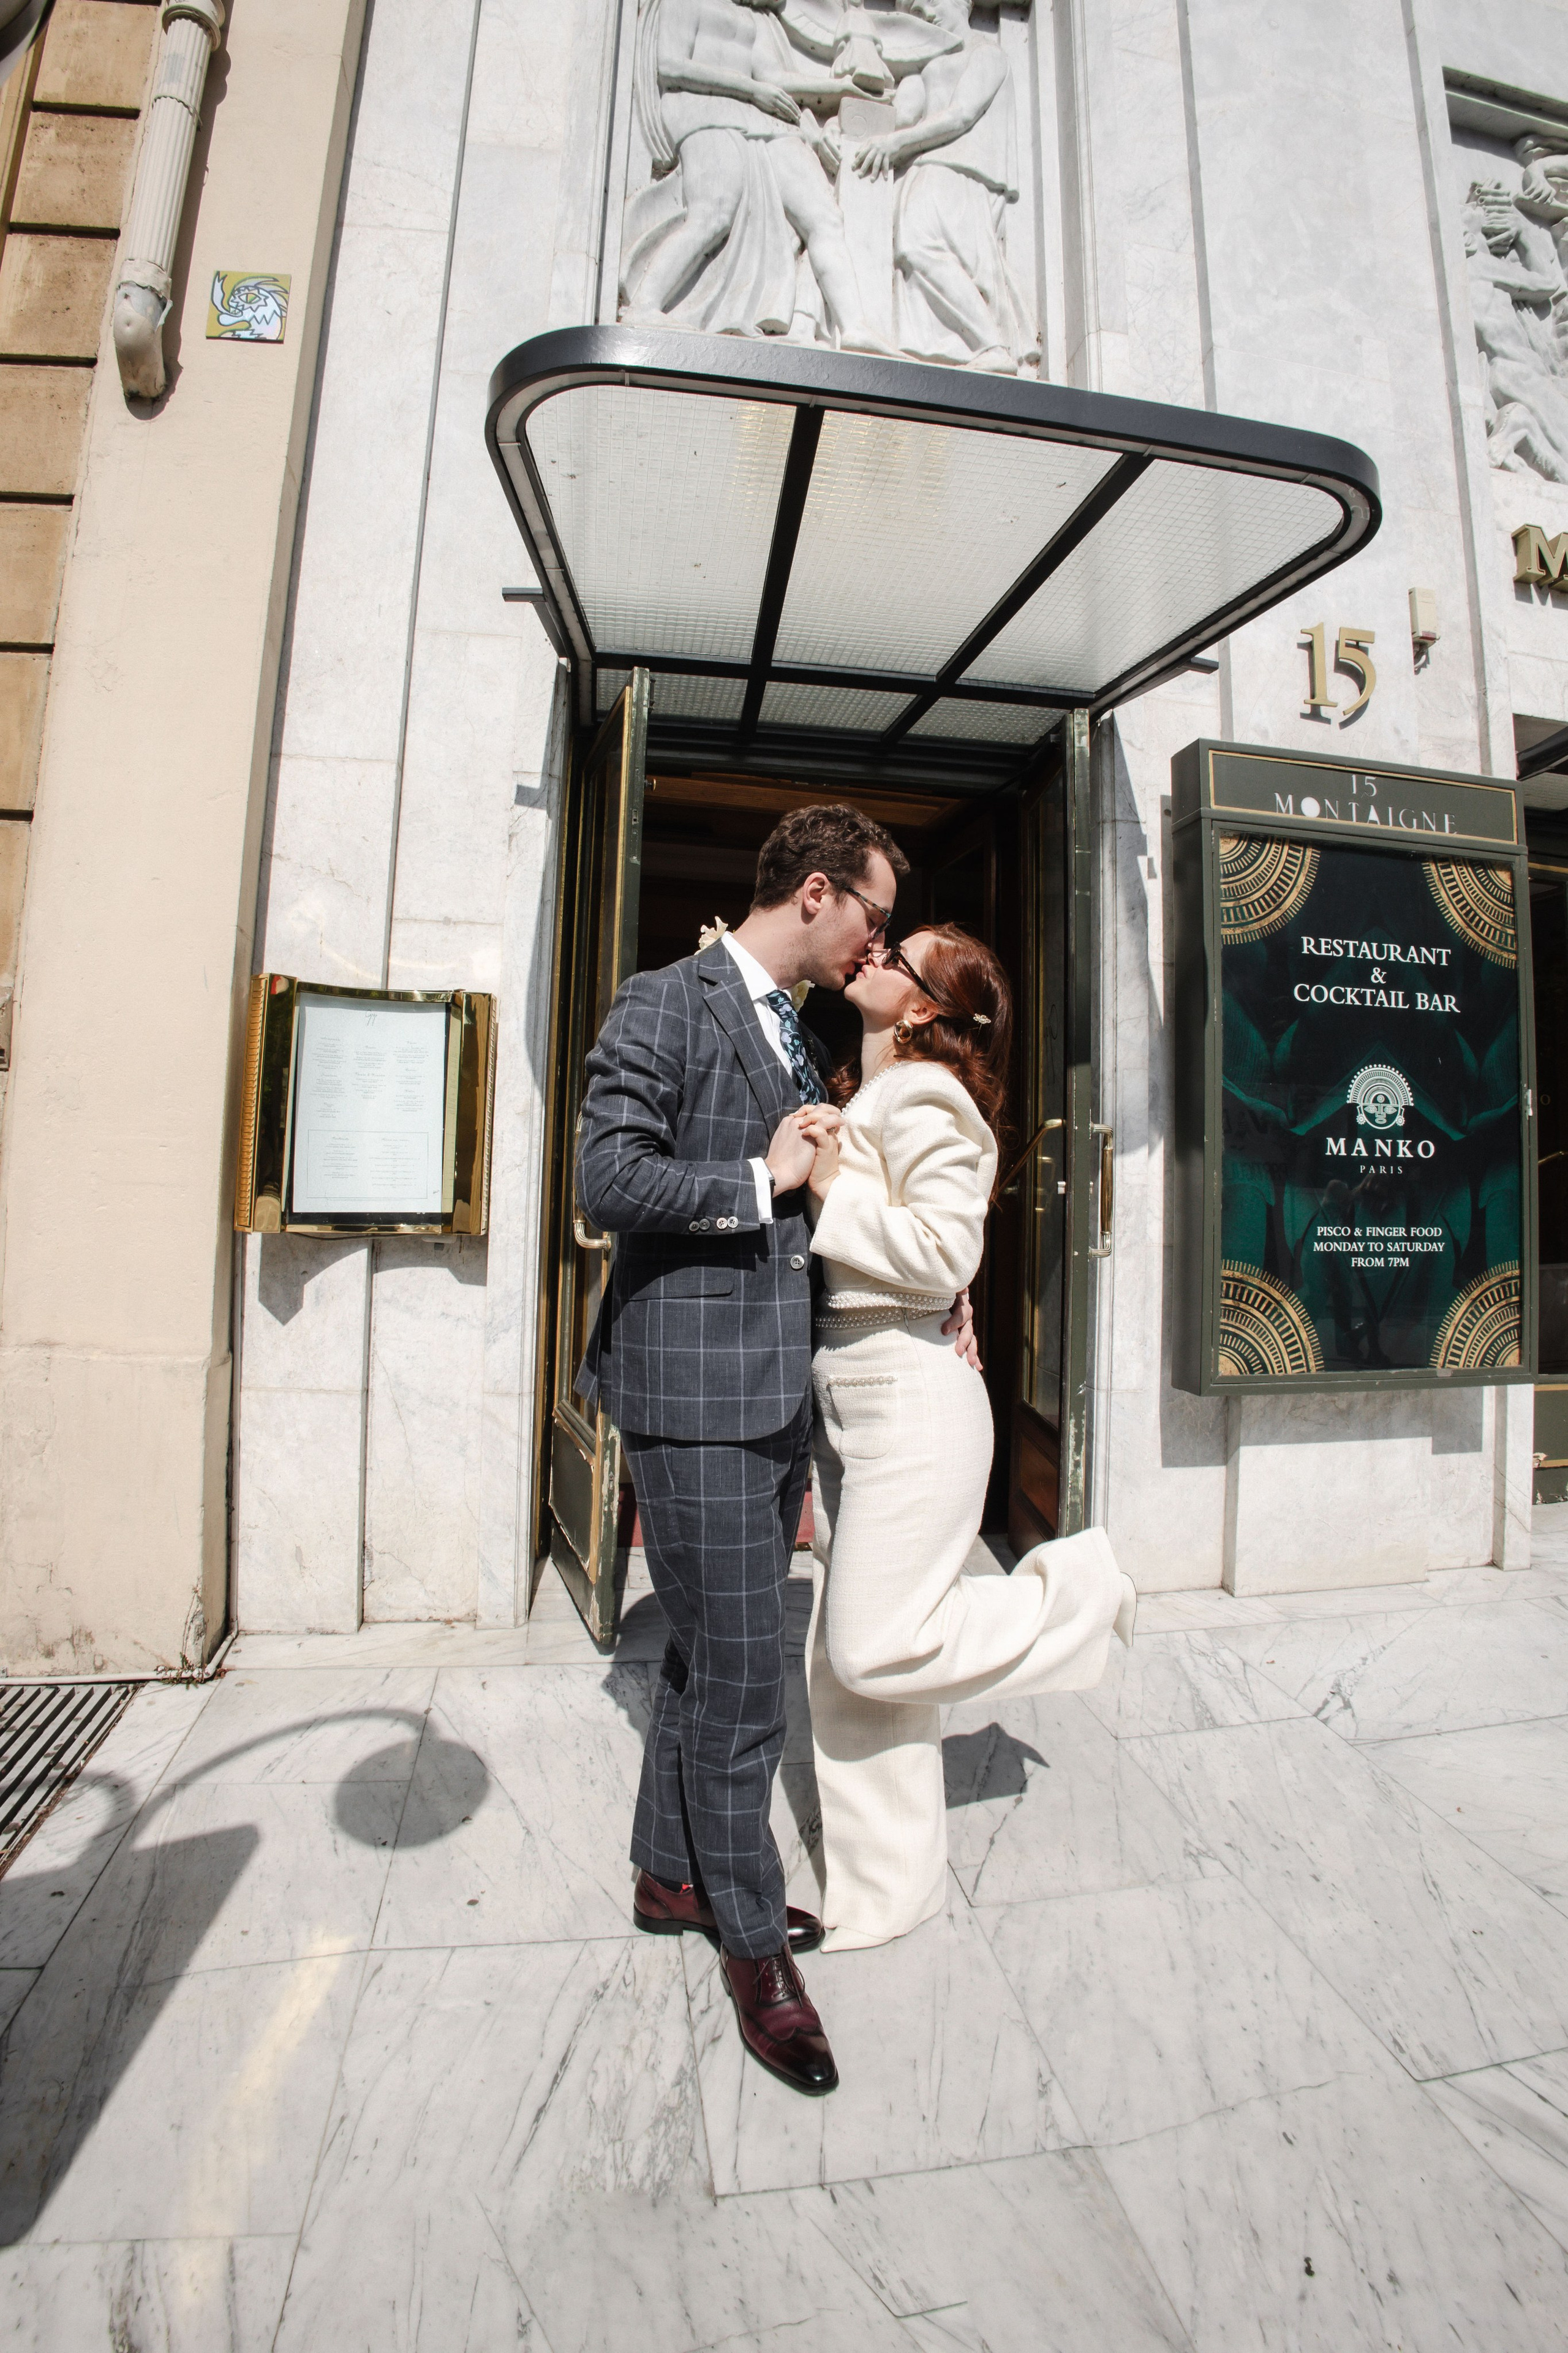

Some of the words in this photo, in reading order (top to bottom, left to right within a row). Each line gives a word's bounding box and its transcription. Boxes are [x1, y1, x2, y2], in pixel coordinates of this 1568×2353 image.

[1300, 622, 1377, 716] 15
[1351, 774, 1378, 797] 15
[1273, 791, 1458, 835] MONTAIGNE
[1301, 936, 1451, 966] RESTAURANT
[1371, 967, 1387, 984] &
[1293, 983, 1409, 1009] COCKTAIL
[1415, 992, 1461, 1013] BAR
[1325, 1137, 1435, 1158] MANKO
[1359, 1165, 1403, 1174] PARIS
[1316, 1226, 1351, 1236] PISCO
[1354, 1227, 1363, 1236] &
[1366, 1227, 1408, 1237] FINGER
[1411, 1227, 1442, 1237] FOOD
[1313, 1242, 1365, 1252] MONDAY
[1367, 1242, 1384, 1252] TO
[1387, 1242, 1446, 1252] SATURDAY
[1351, 1257, 1385, 1267] FROM
[1387, 1257, 1409, 1267] 7PM
